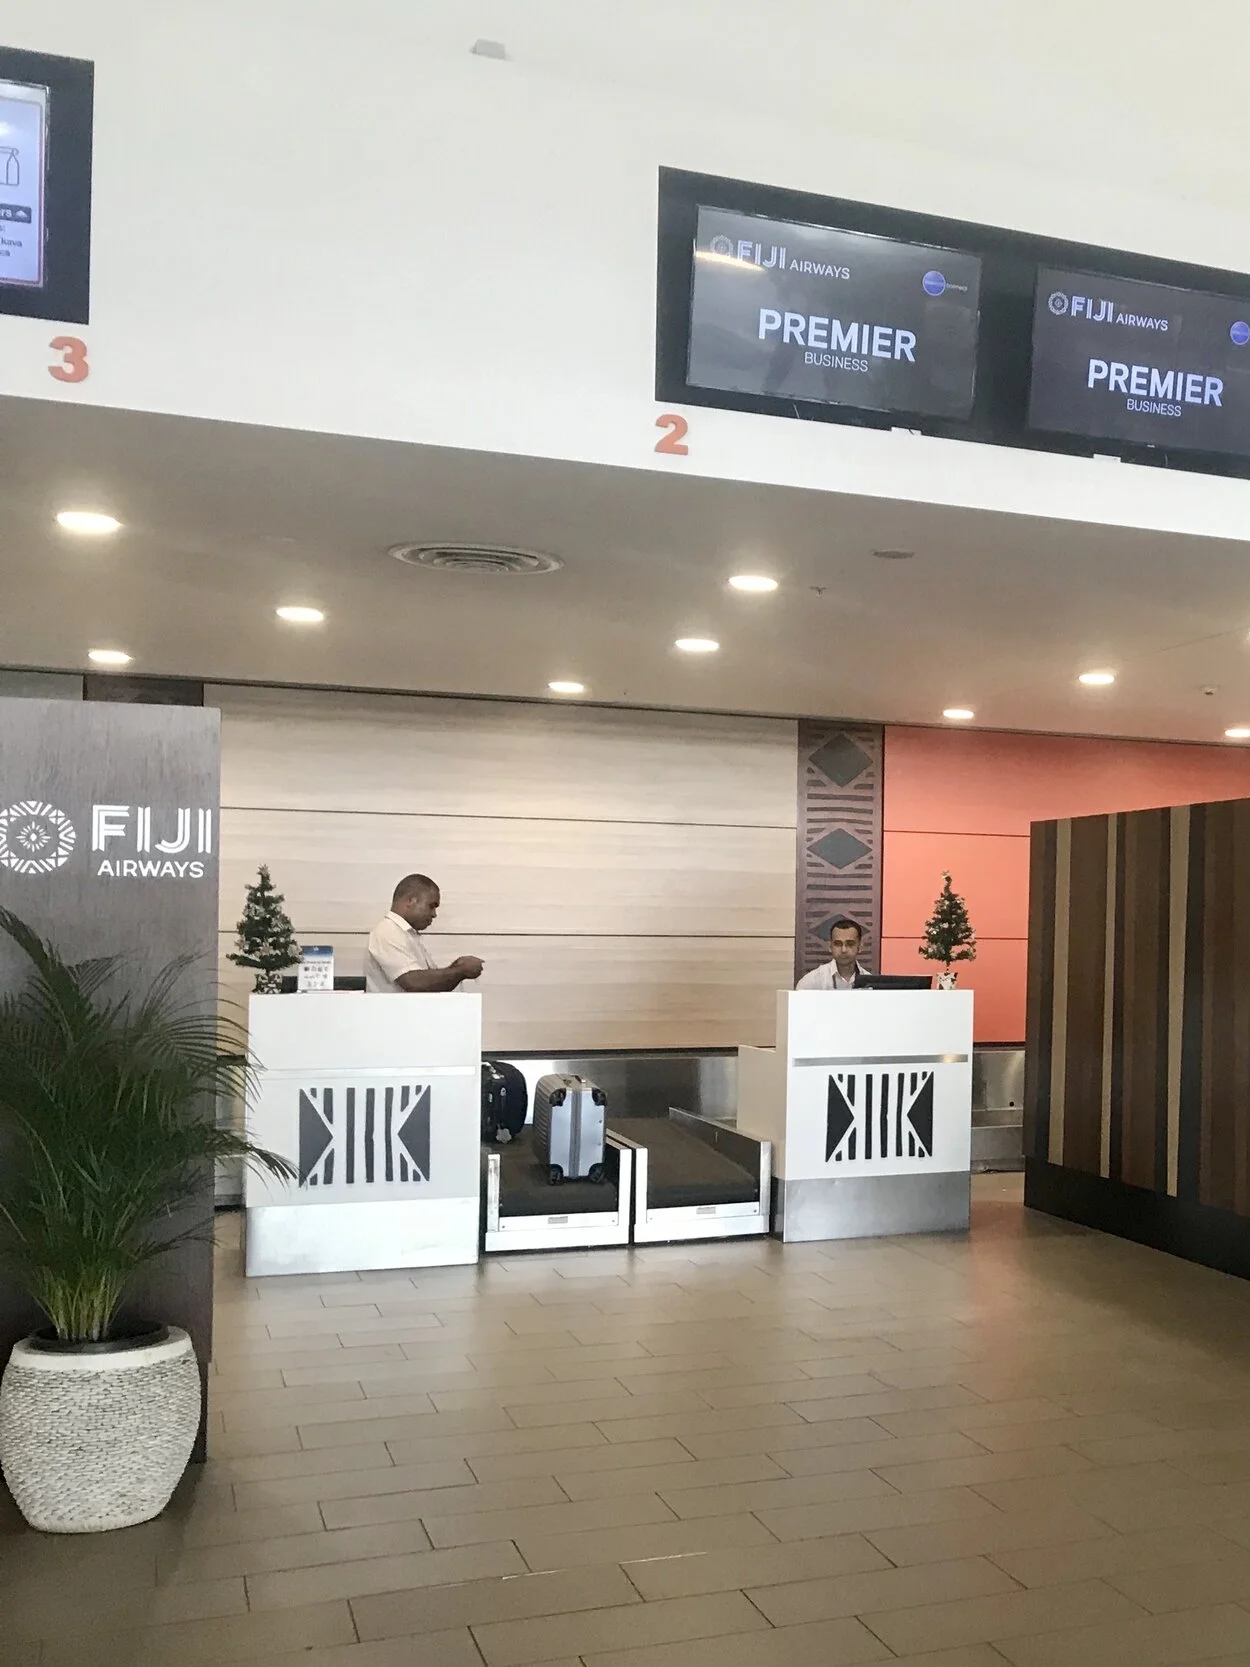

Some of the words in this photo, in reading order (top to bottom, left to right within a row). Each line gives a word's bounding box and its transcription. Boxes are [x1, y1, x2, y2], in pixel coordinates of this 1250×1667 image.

[737, 239, 786, 269] FIJI
[789, 259, 850, 280] AIRWAYS
[1071, 295, 1114, 323] FIJI
[1116, 313, 1168, 331] AIRWAYS
[758, 308, 916, 362] PREMIER
[48, 335, 90, 383] 3
[804, 351, 868, 372] BUSINESS
[1087, 358, 1224, 407] PREMIER
[1126, 398, 1182, 417] BUSINESS
[654, 413, 689, 455] 2
[92, 804, 212, 854] FIJI
[97, 859, 204, 879] AIRWAYS
